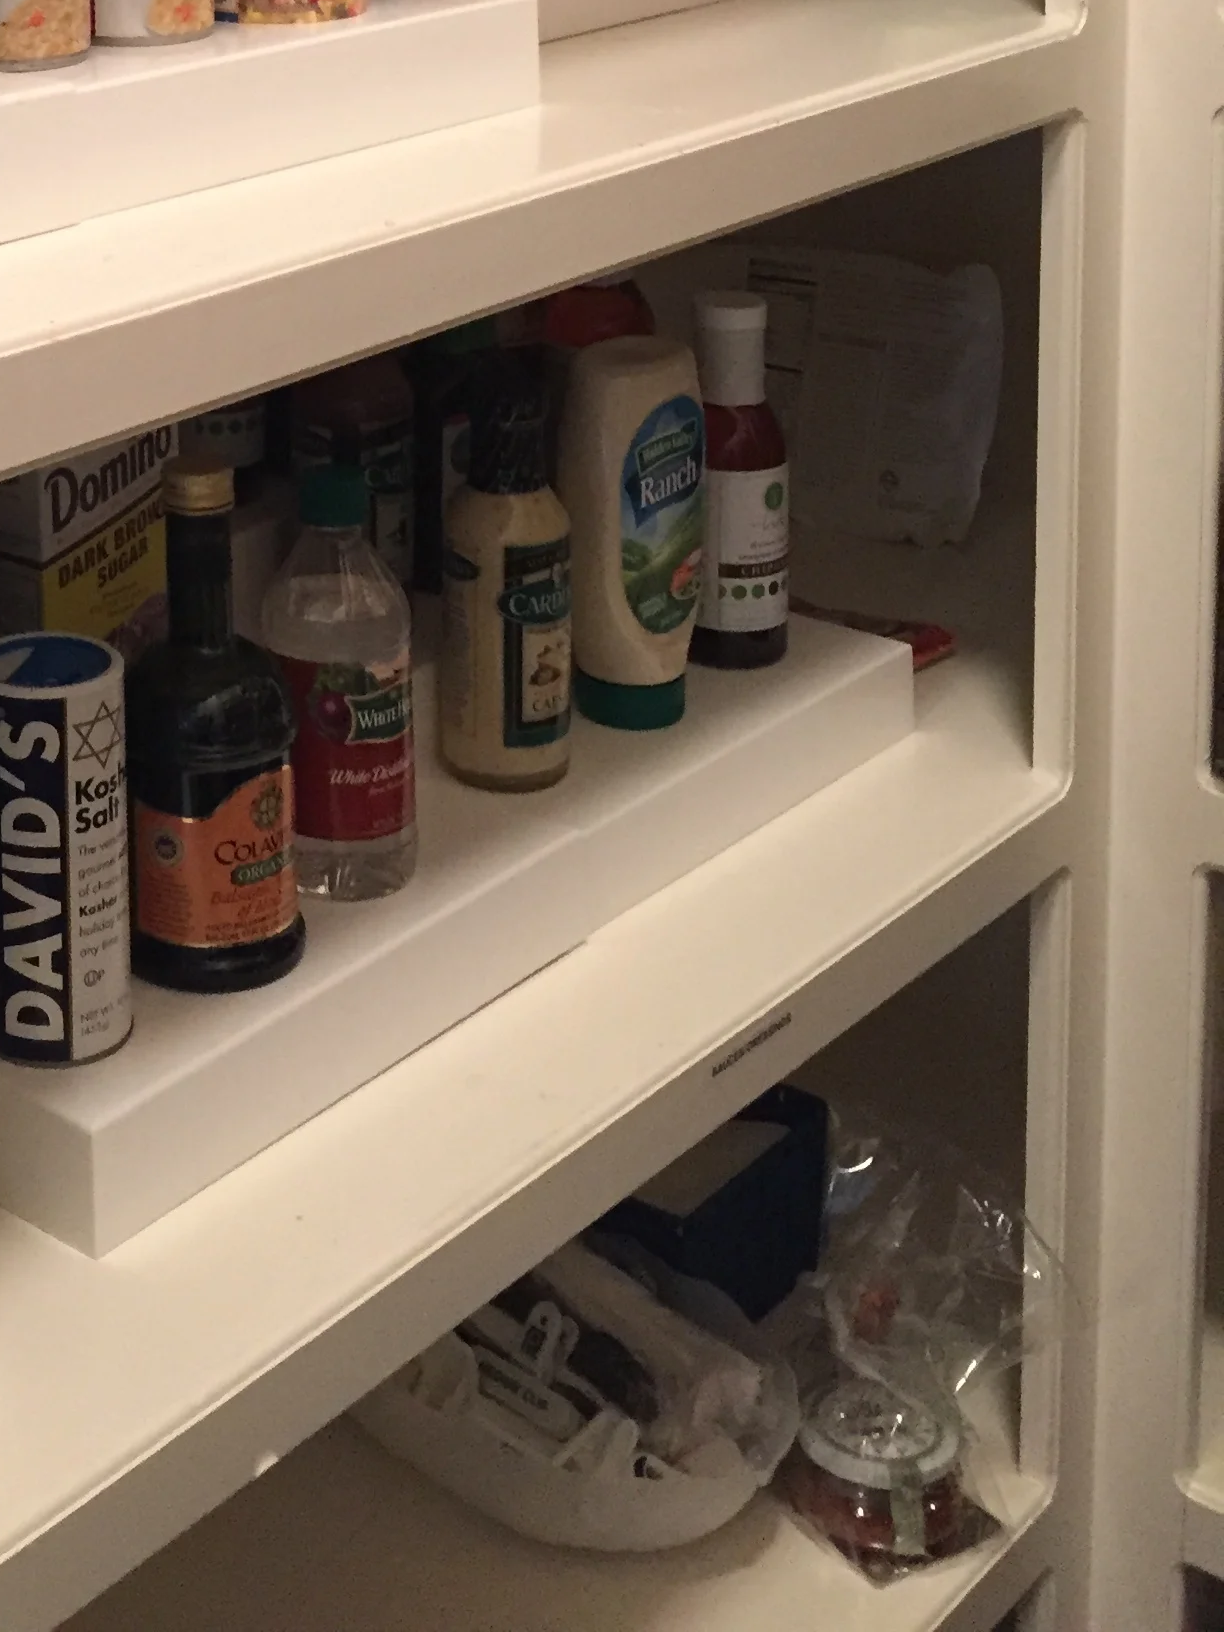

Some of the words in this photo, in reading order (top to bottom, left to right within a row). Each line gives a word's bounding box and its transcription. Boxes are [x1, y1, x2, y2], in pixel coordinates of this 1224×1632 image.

[43, 423, 172, 535] Domino
[640, 456, 698, 509] Ranch
[58, 540, 111, 589] DARK
[96, 534, 150, 590] SUGAR
[75, 795, 121, 835] Salt
[77, 842, 97, 859] The
[78, 880, 91, 899] of
[78, 893, 119, 920] Kosher
